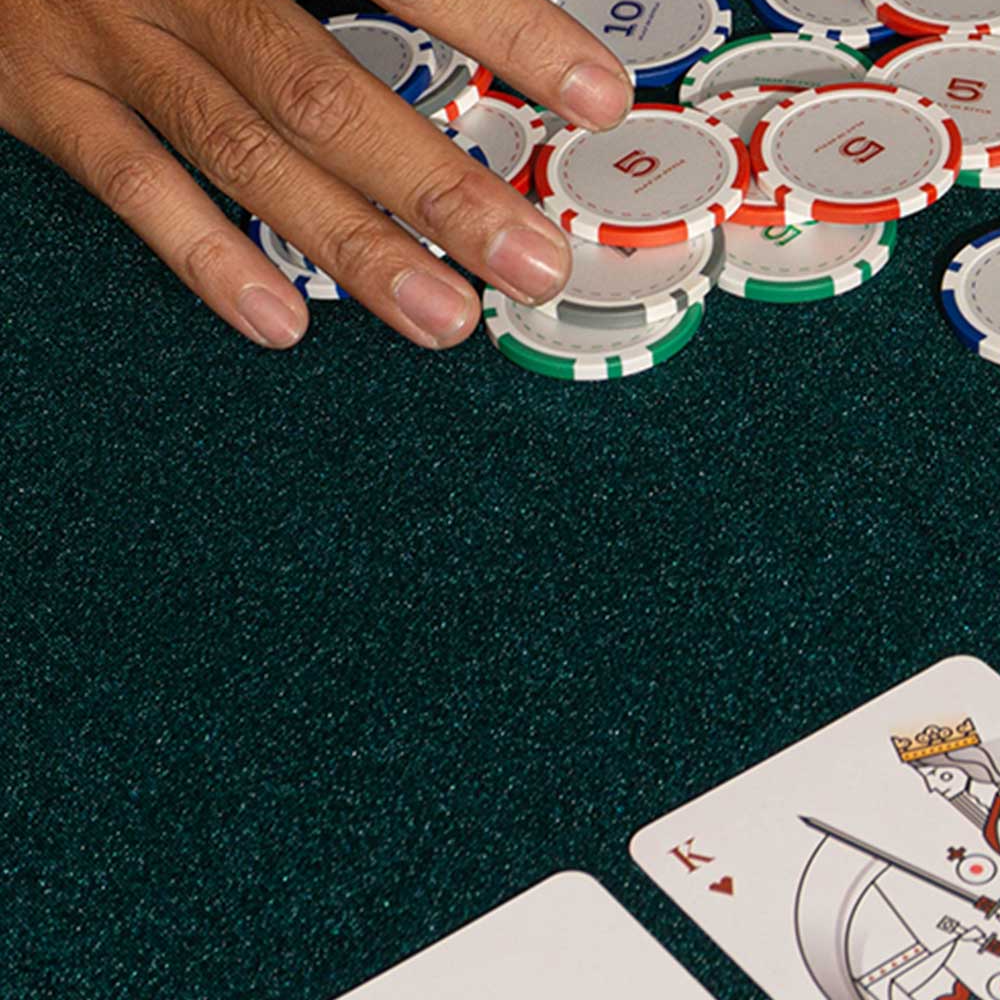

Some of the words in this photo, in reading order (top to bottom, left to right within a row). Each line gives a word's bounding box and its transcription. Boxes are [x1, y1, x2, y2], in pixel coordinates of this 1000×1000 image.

[603, 0, 644, 37] 10
[946, 77, 988, 103] 5
[613, 149, 660, 178] 5
[839, 136, 885, 165] 5
[666, 836, 716, 874] K
